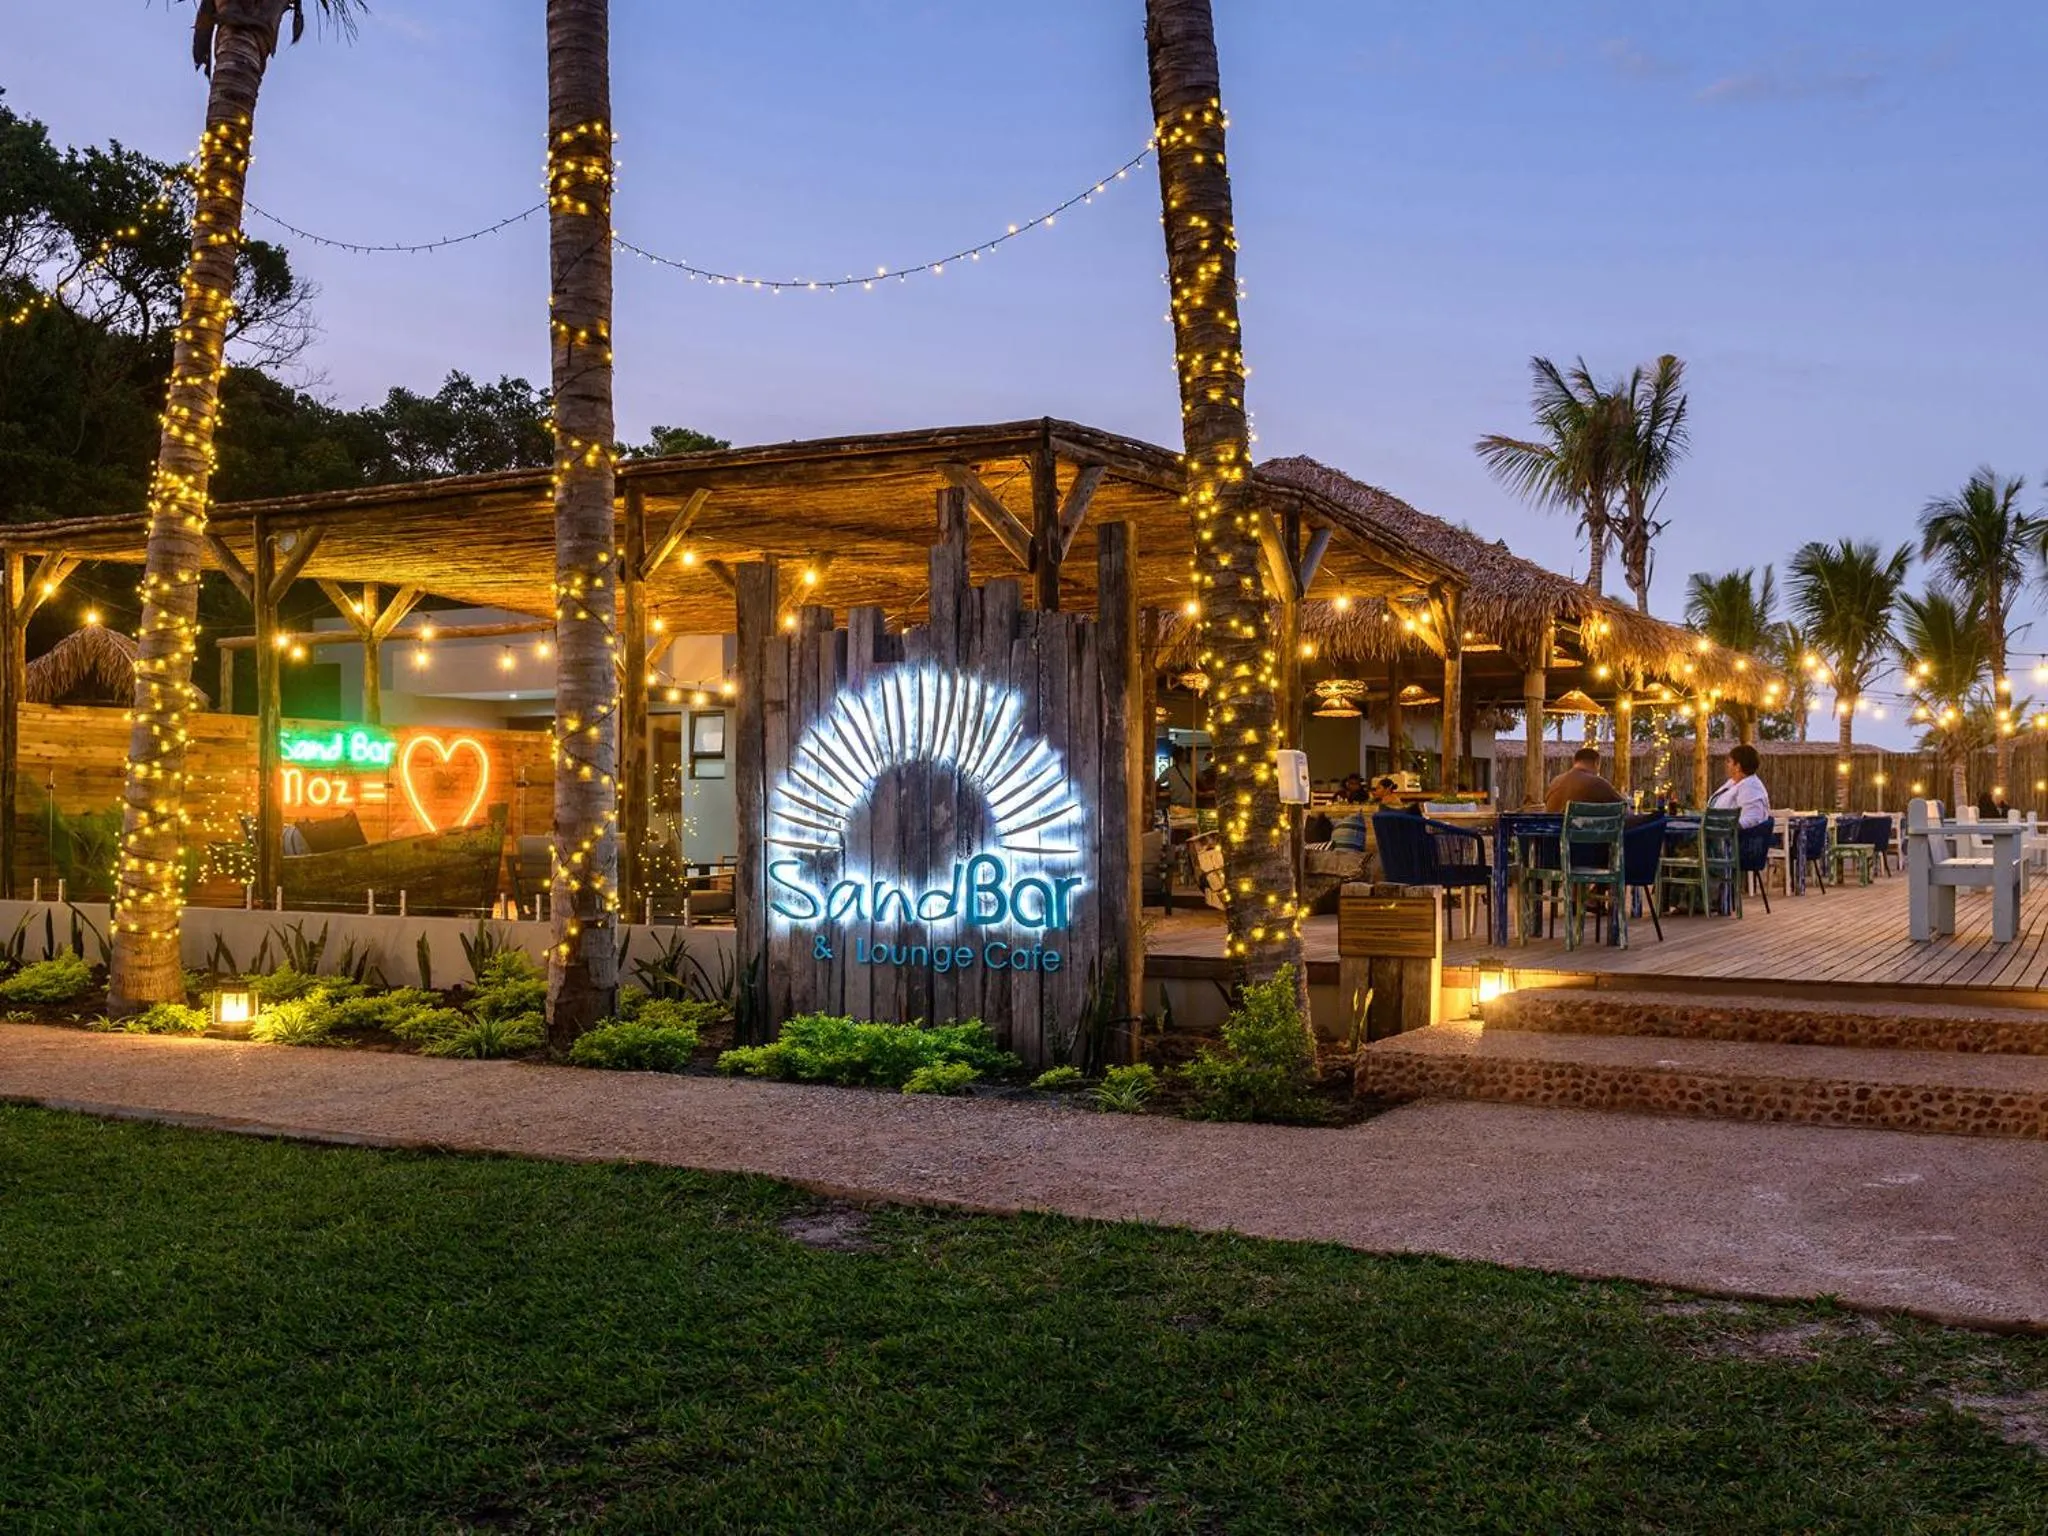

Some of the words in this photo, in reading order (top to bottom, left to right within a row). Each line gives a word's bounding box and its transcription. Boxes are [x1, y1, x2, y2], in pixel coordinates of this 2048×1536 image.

[351, 731, 395, 763] Bar
[813, 934, 833, 960] &
[855, 937, 974, 973] Lounge
[984, 941, 1062, 972] Cafe
